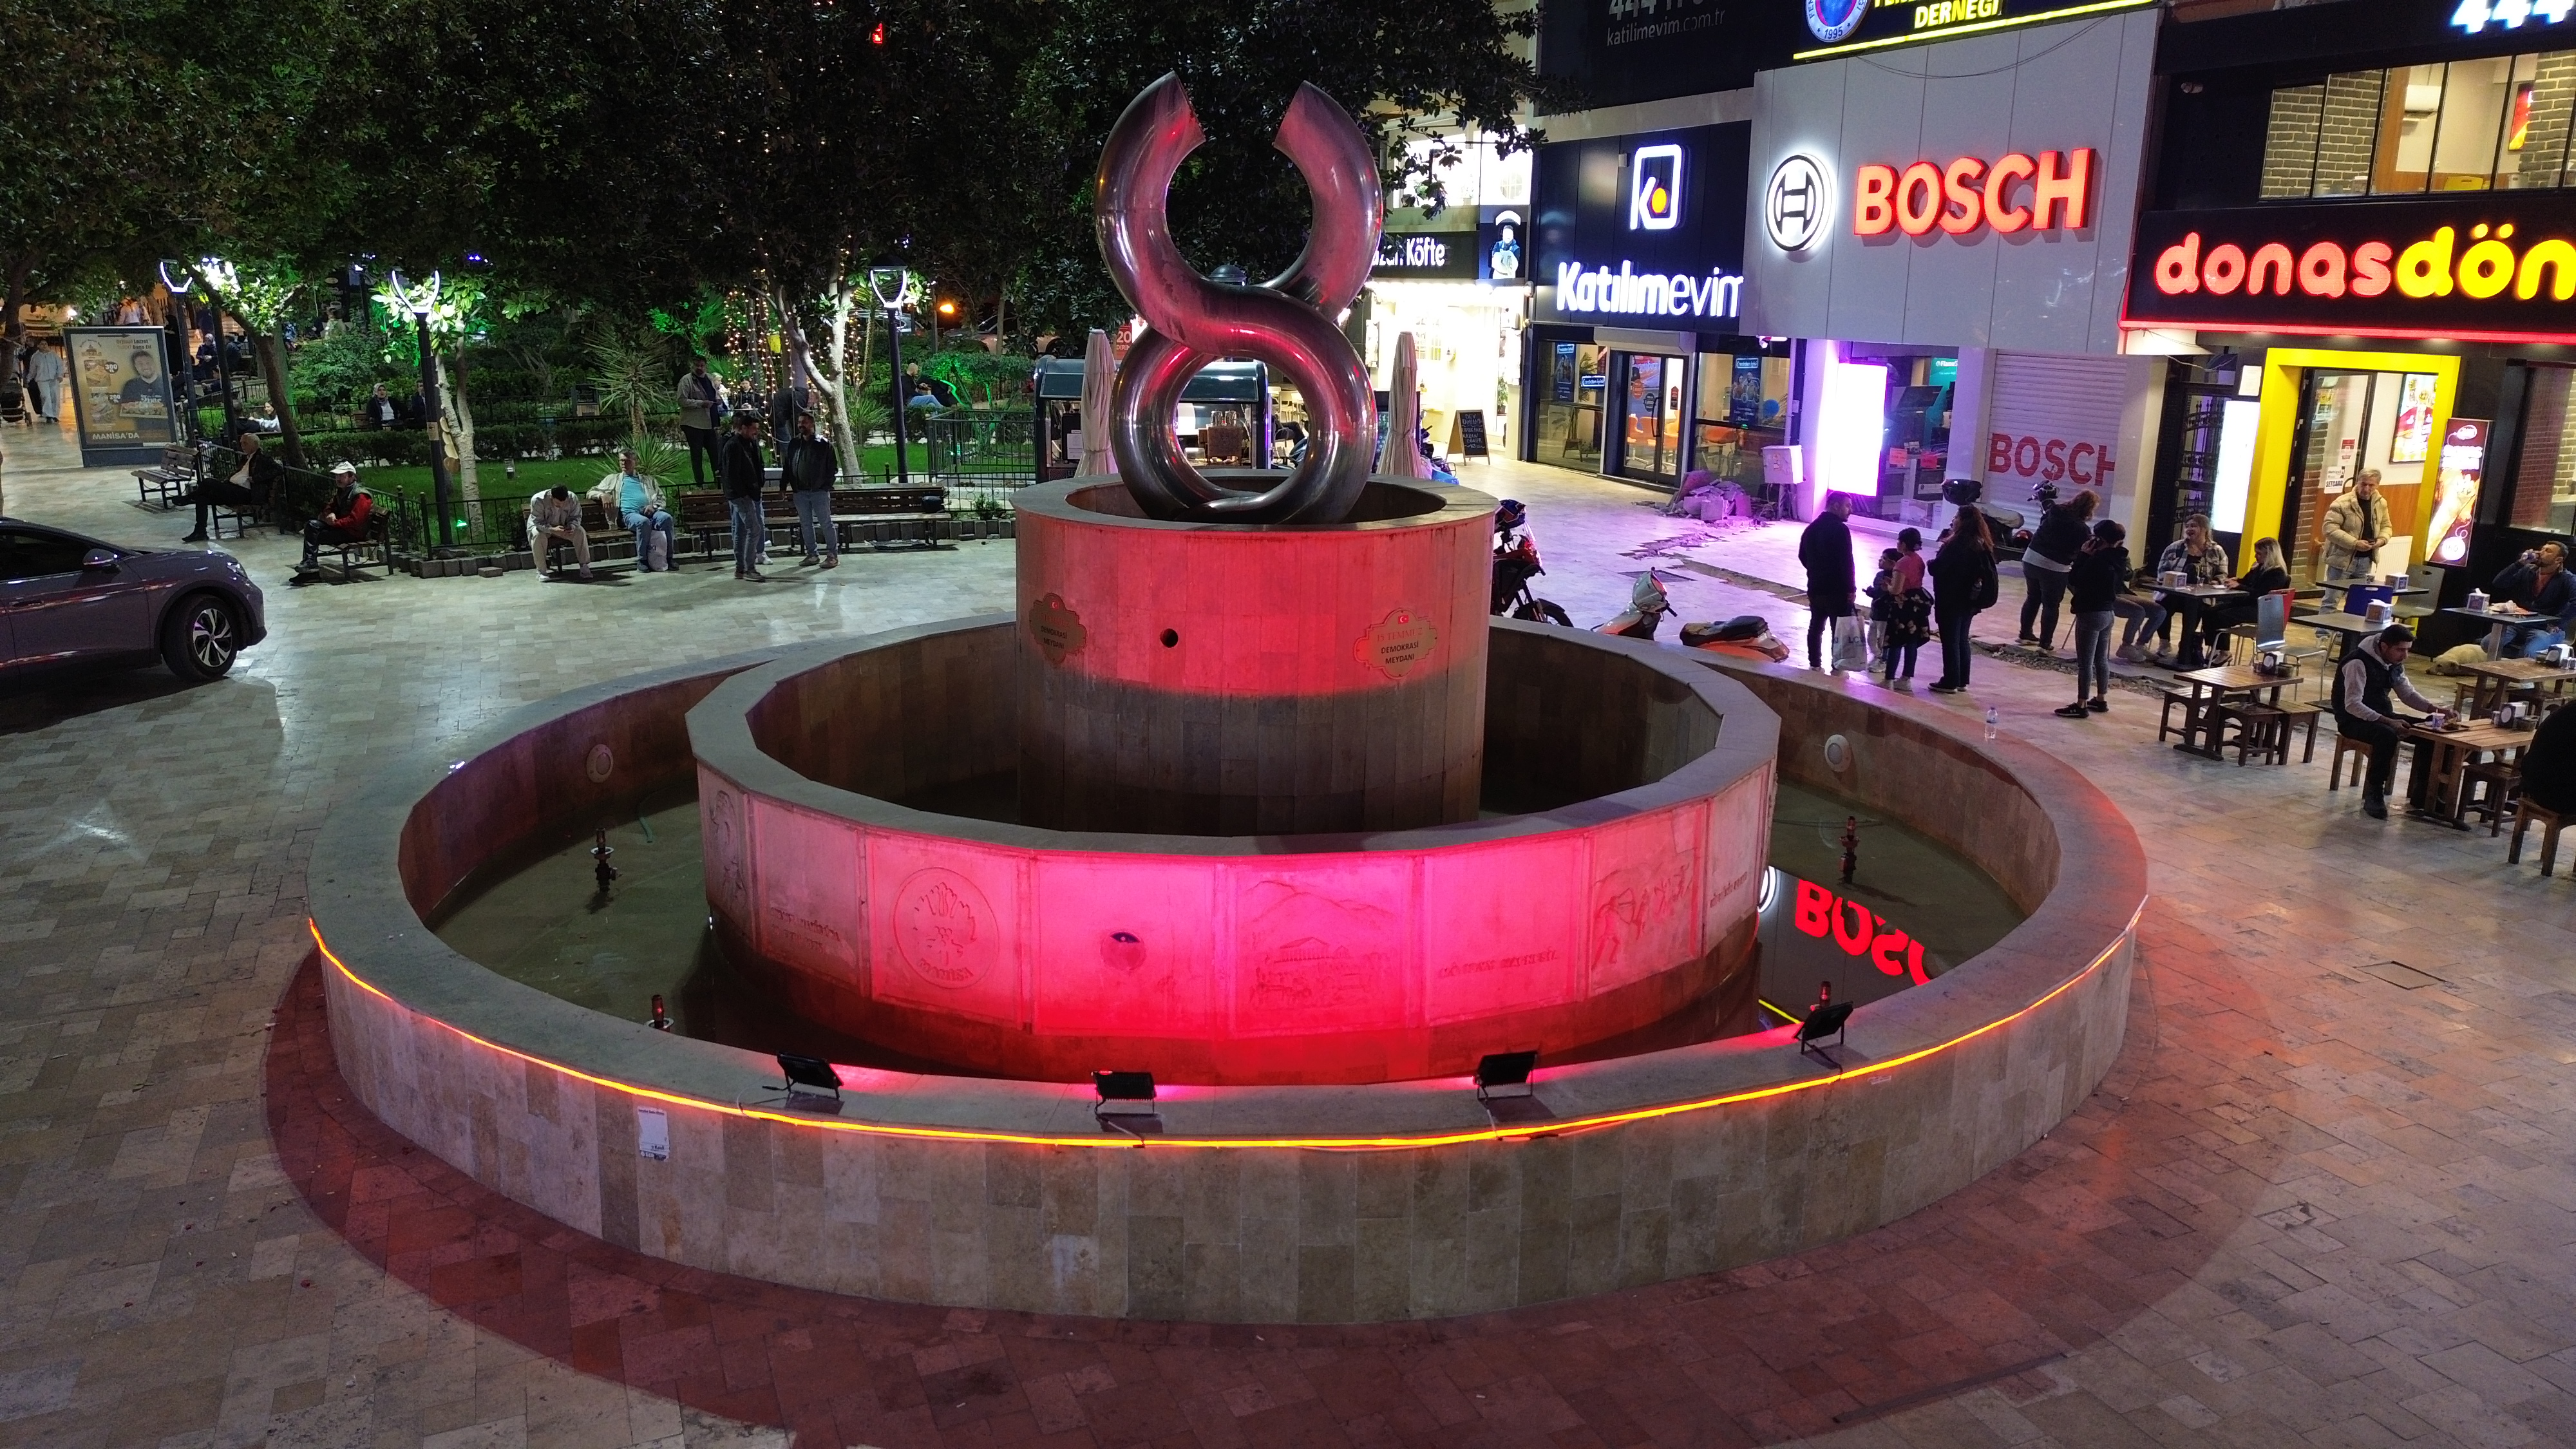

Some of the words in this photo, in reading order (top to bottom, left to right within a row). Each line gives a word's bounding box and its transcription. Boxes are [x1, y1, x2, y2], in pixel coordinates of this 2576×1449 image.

[1607, 8, 1725, 46] katilimevim.com.tr
[1824, 26, 1843, 39] 1995
[1853, 147, 2096, 236] BOSCH
[1406, 236, 1445, 267] Köfte
[1116, 330, 1132, 343] 20
[1988, 433, 2116, 487] BOSCH
[1381, 641, 1419, 654] DEMOKRASİ
[1385, 653, 1414, 664] MEYDANI
